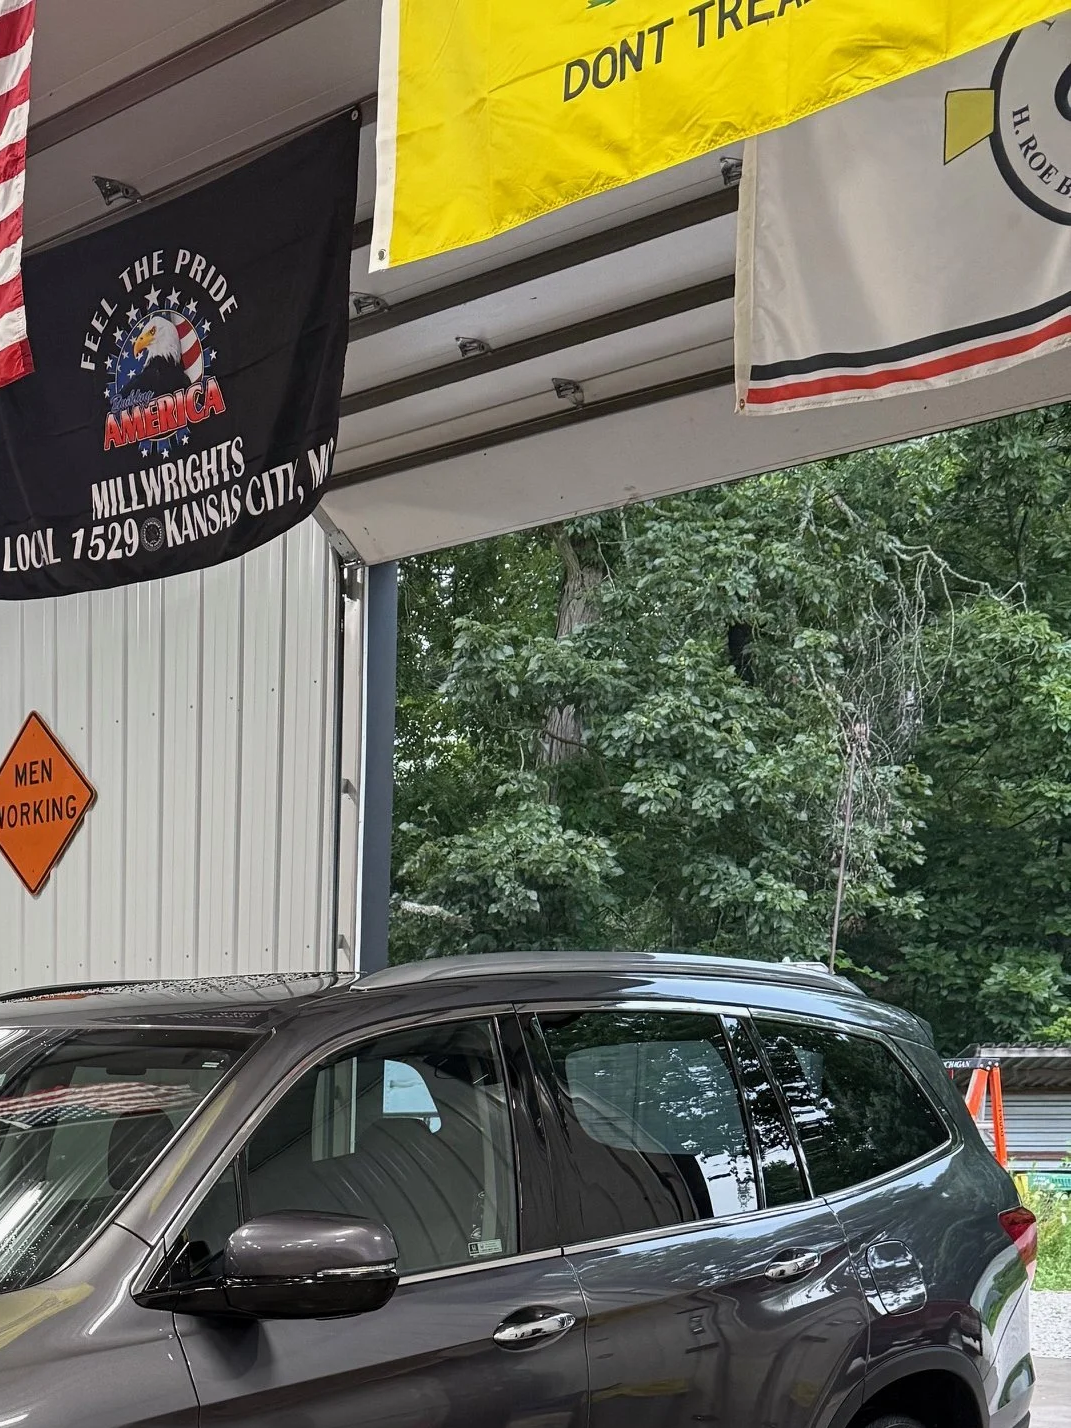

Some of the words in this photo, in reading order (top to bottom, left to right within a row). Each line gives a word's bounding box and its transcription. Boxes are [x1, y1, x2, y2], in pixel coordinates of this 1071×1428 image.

[563, 17, 674, 103] DONT
[1012, 104, 1030, 135] H.
[1018, 134, 1059, 185] ROE
[80, 298, 118, 371] FEEL
[118, 250, 164, 293] THE
[174, 249, 238, 323] PRIDE
[104, 375, 226, 451] AMERICA
[71, 518, 139, 561] 1529
[164, 484, 242, 548] KANSAS
[245, 458, 305, 516] CITY,
[91, 436, 245, 521] MILLWRIGHTS
[14, 757, 53, 788] MEN
